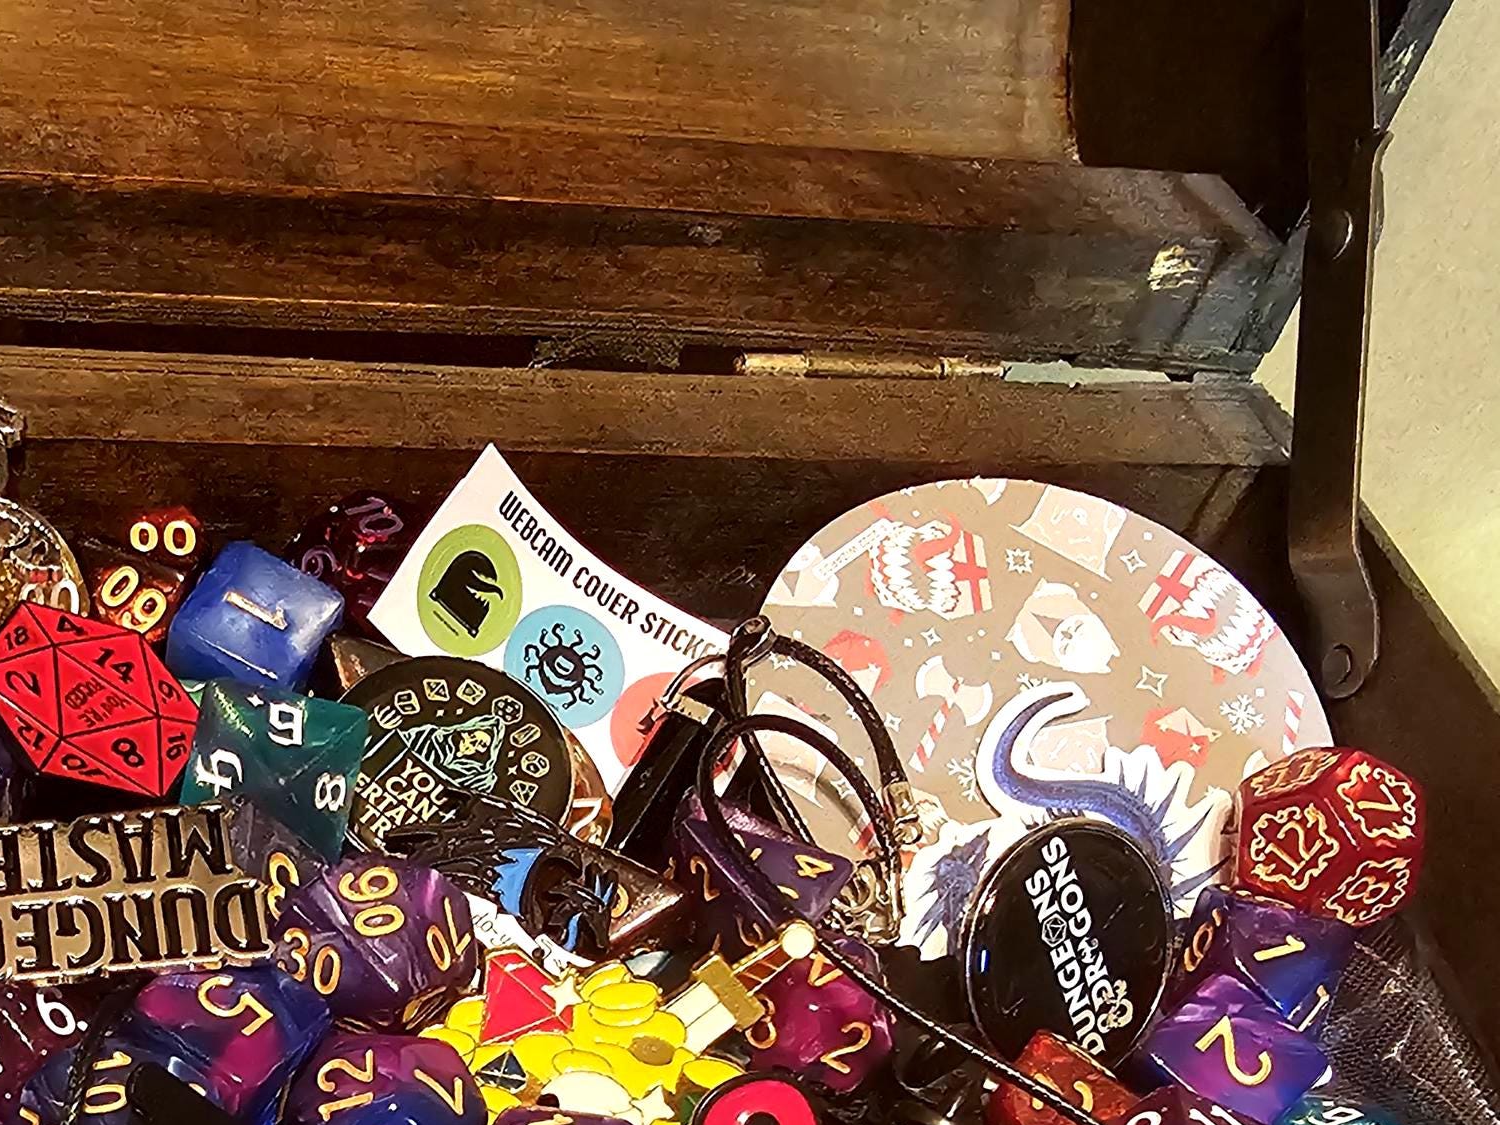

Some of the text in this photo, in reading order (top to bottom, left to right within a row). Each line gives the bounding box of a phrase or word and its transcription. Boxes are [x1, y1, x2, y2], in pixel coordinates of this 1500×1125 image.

[130, 521, 196, 556] 00
[499, 490, 573, 577] WEBCAM
[572, 566, 639, 624] COVER
[4, 628, 29, 651] 18
[58, 616, 88, 636] 4
[5, 671, 40, 696] 2
[111, 736, 145, 768] 8
[164, 733, 187, 761] 16
[385, 776, 440, 822] CAN
[400, 758, 449, 806] YOU
[1356, 784, 1401, 812] 7
[360, 804, 392, 839] TR
[796, 854, 835, 881] 4
[1346, 875, 1390, 905] 8
[278, 929, 342, 993] 30
[1254, 935, 1305, 962] 1
[199, 977, 273, 1036] 5
[820, 1022, 870, 1073] 2
[1195, 1016, 1271, 1086] 2
[317, 1049, 373, 1120] 12
[415, 1068, 463, 1116] 7
